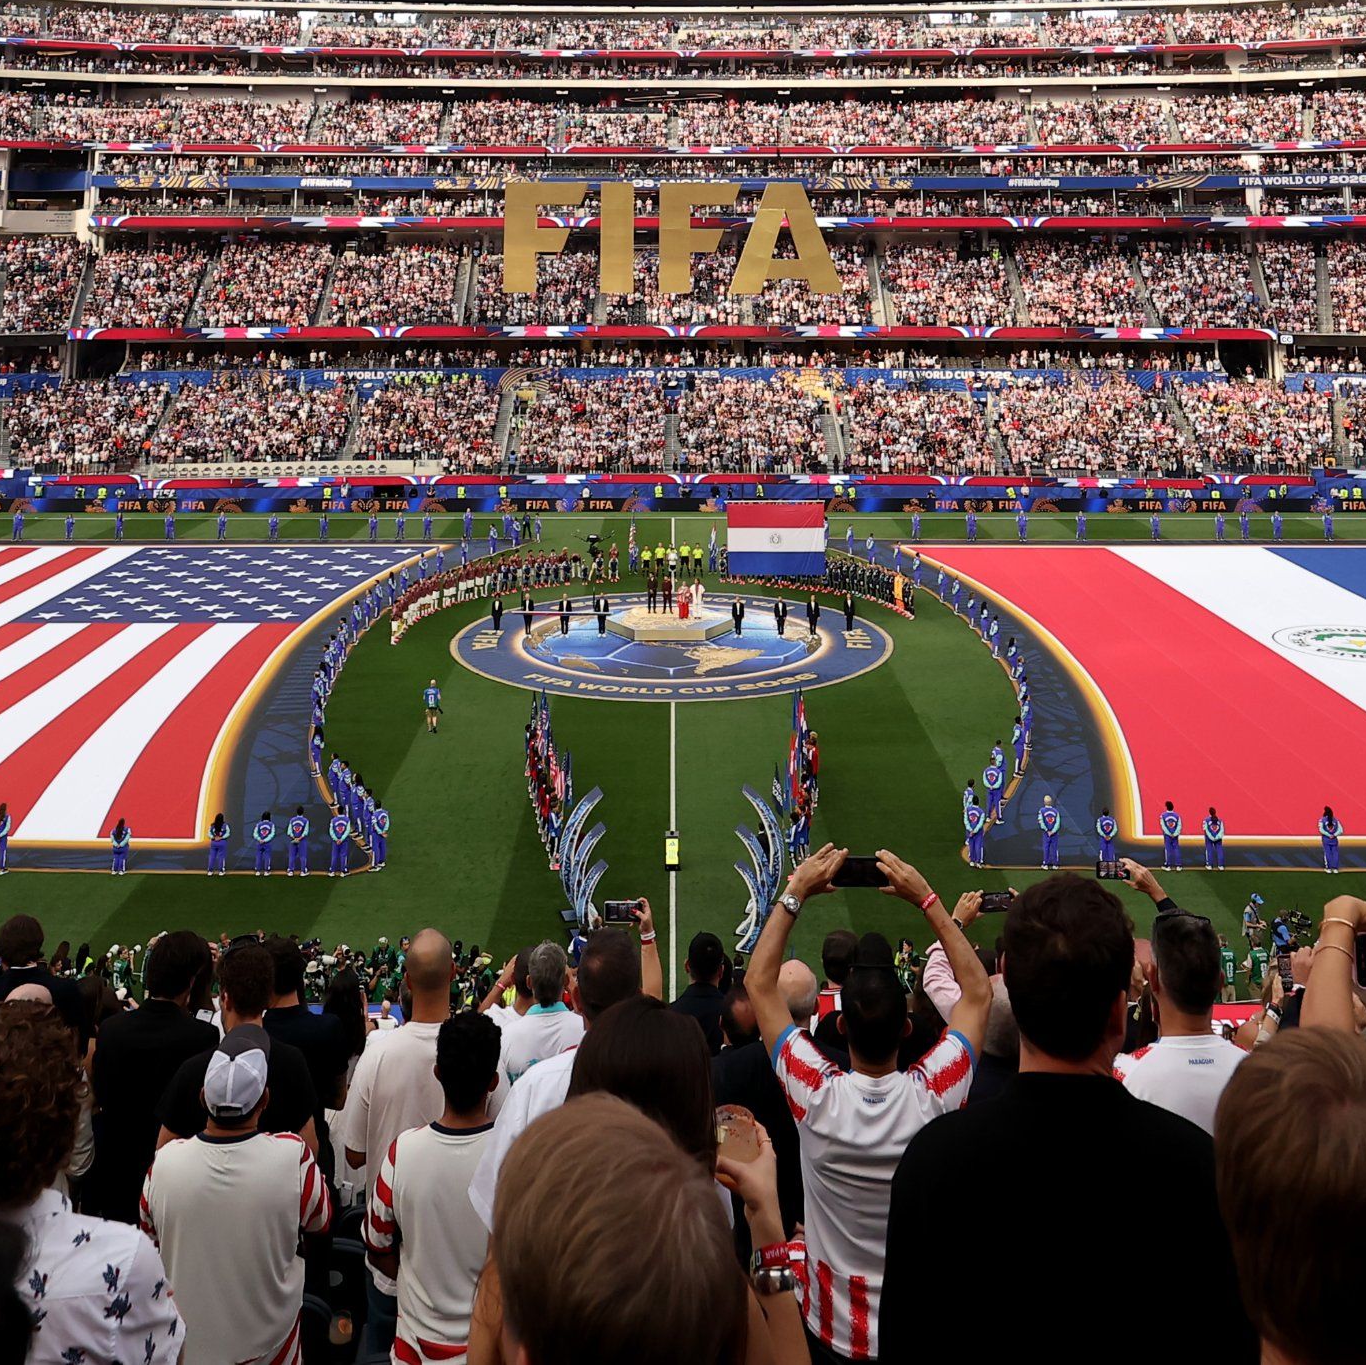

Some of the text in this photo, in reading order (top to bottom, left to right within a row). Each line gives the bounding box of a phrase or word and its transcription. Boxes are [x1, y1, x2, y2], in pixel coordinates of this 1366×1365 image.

[300, 178, 352, 188] #FIFAWorldCup
[1008, 178, 1060, 188] #FIFAWorldCup
[1238, 175, 1262, 186] FIFA
[1263, 176, 1303, 185] WORLD
[1305, 175, 1328, 185] CUP
[503, 182, 843, 294] FIFA
[628, 370, 655, 378] LOS
[893, 370, 914, 379] FIFA
[955, 370, 975, 379] CUP
[118, 501, 141, 510] FIFA
[181, 501, 205, 510] FIFA
[322, 501, 345, 510] FIFA
[386, 501, 409, 510] FIFA
[525, 501, 549, 510] FIFA
[589, 501, 613, 510] FIFA
[935, 501, 958, 510] FIFA
[998, 501, 1022, 510] FIFA
[1139, 501, 1163, 510] FIFA
[1202, 501, 1226, 510] FIFA
[1342, 501, 1366, 510] FIFA
[522, 671, 817, 694] FIFA WORLD CUP 2026
[1188, 1058, 1215, 1066] PARAGUAY
[863, 1096, 887, 1104] PARAGUAY
